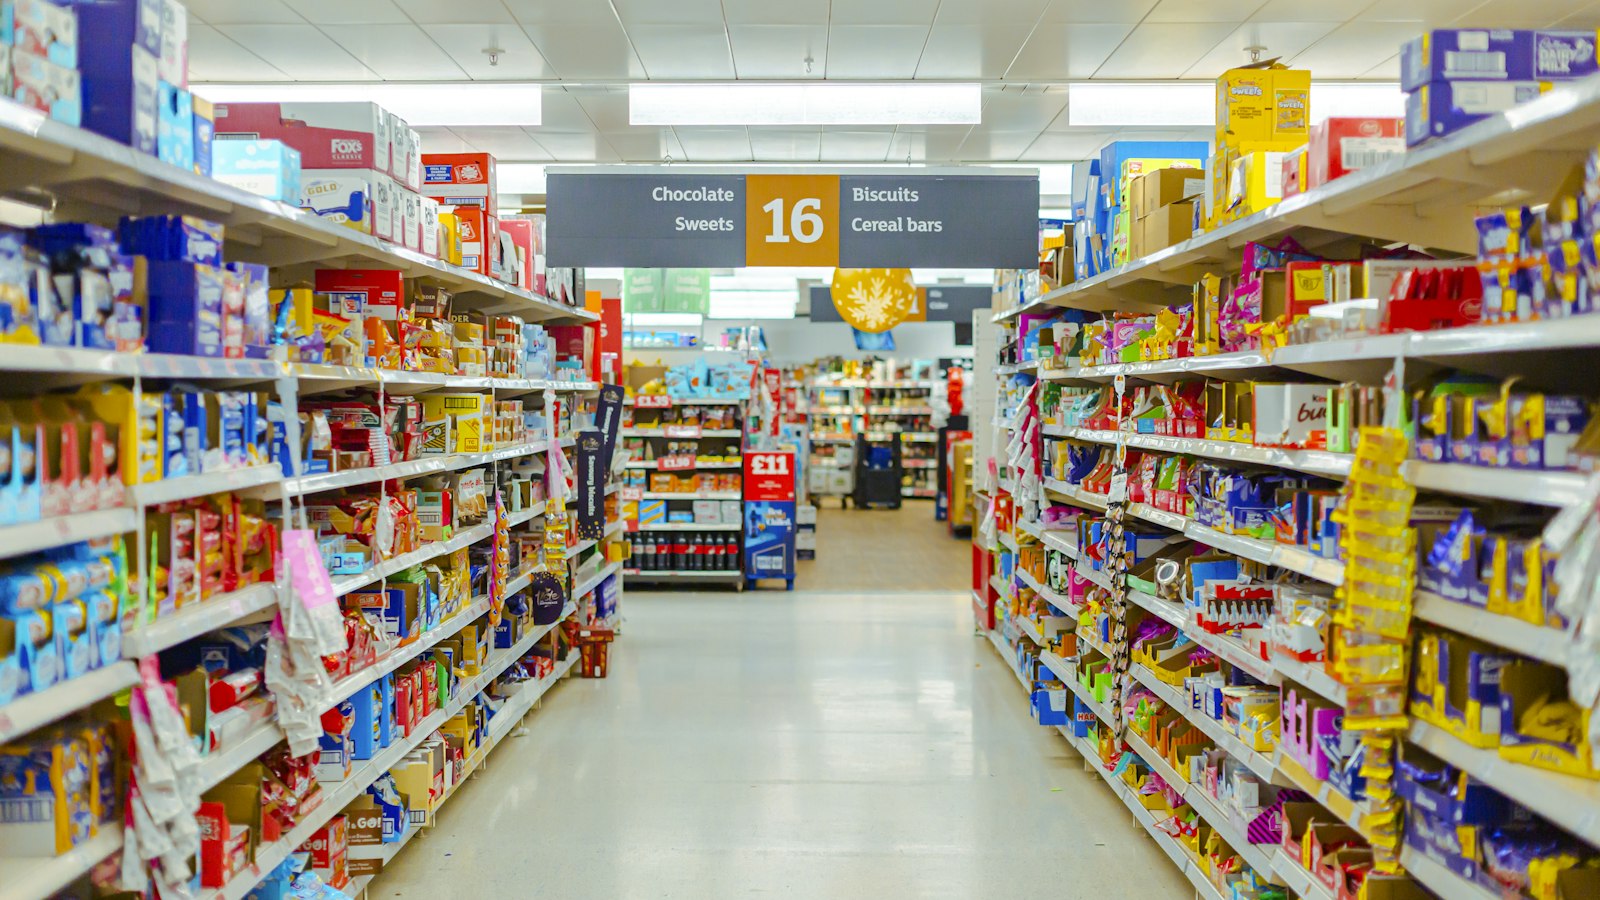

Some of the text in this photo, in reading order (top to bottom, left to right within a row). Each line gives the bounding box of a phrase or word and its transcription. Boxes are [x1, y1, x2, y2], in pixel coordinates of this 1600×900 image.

[1231, 85, 1263, 96] SWEETS
[307, 183, 338, 195] GOLD
[652, 186, 735, 202] Chocolate
[852, 186, 919, 202] Biscuits
[675, 216, 735, 232] Sweets
[762, 197, 824, 244] 16
[851, 216, 943, 233] Cereal bars
[750, 454, 790, 476] £11
[587, 455, 596, 517] Savoury biscuits
